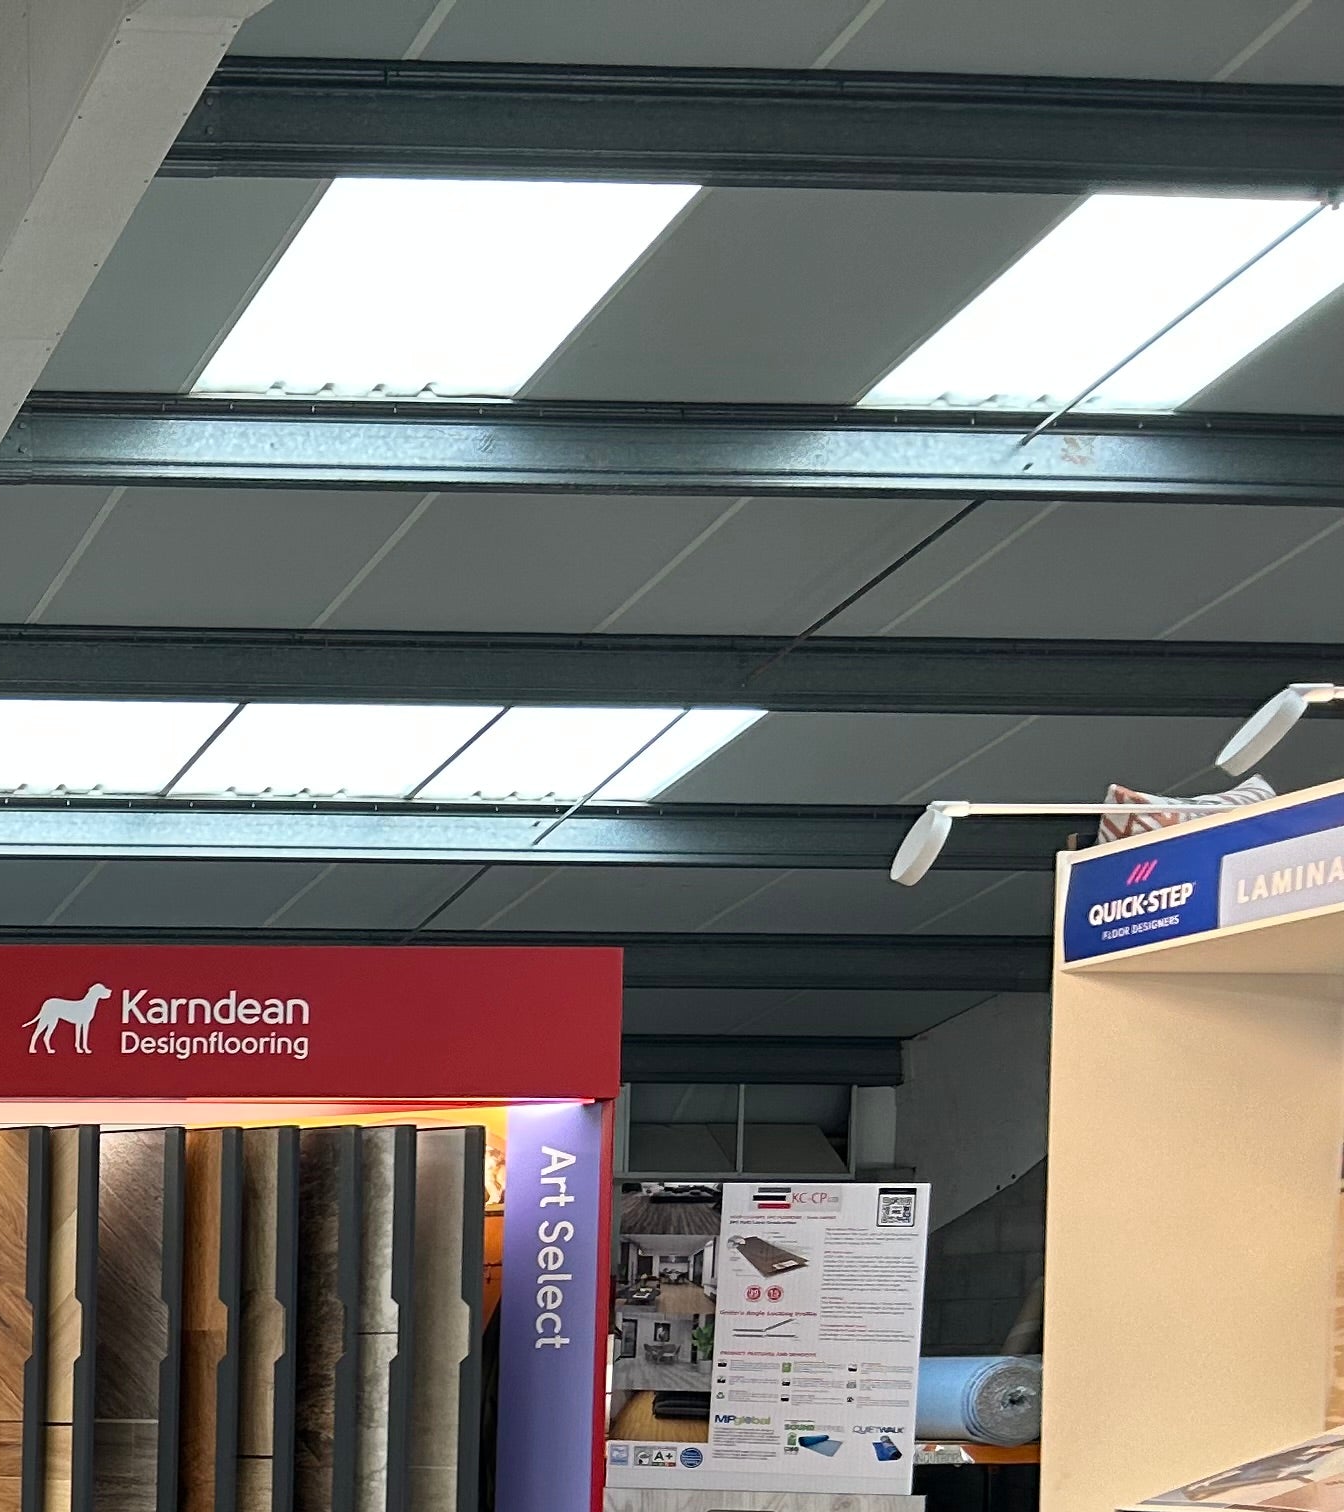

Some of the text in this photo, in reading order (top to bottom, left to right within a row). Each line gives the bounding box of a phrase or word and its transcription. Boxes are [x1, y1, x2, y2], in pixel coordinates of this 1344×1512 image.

[1130, 914, 1180, 935] DESIGNERS
[121, 989, 310, 1025] Karndean
[120, 1031, 310, 1060] Designflooring
[534, 1145, 577, 1350] Art Select
